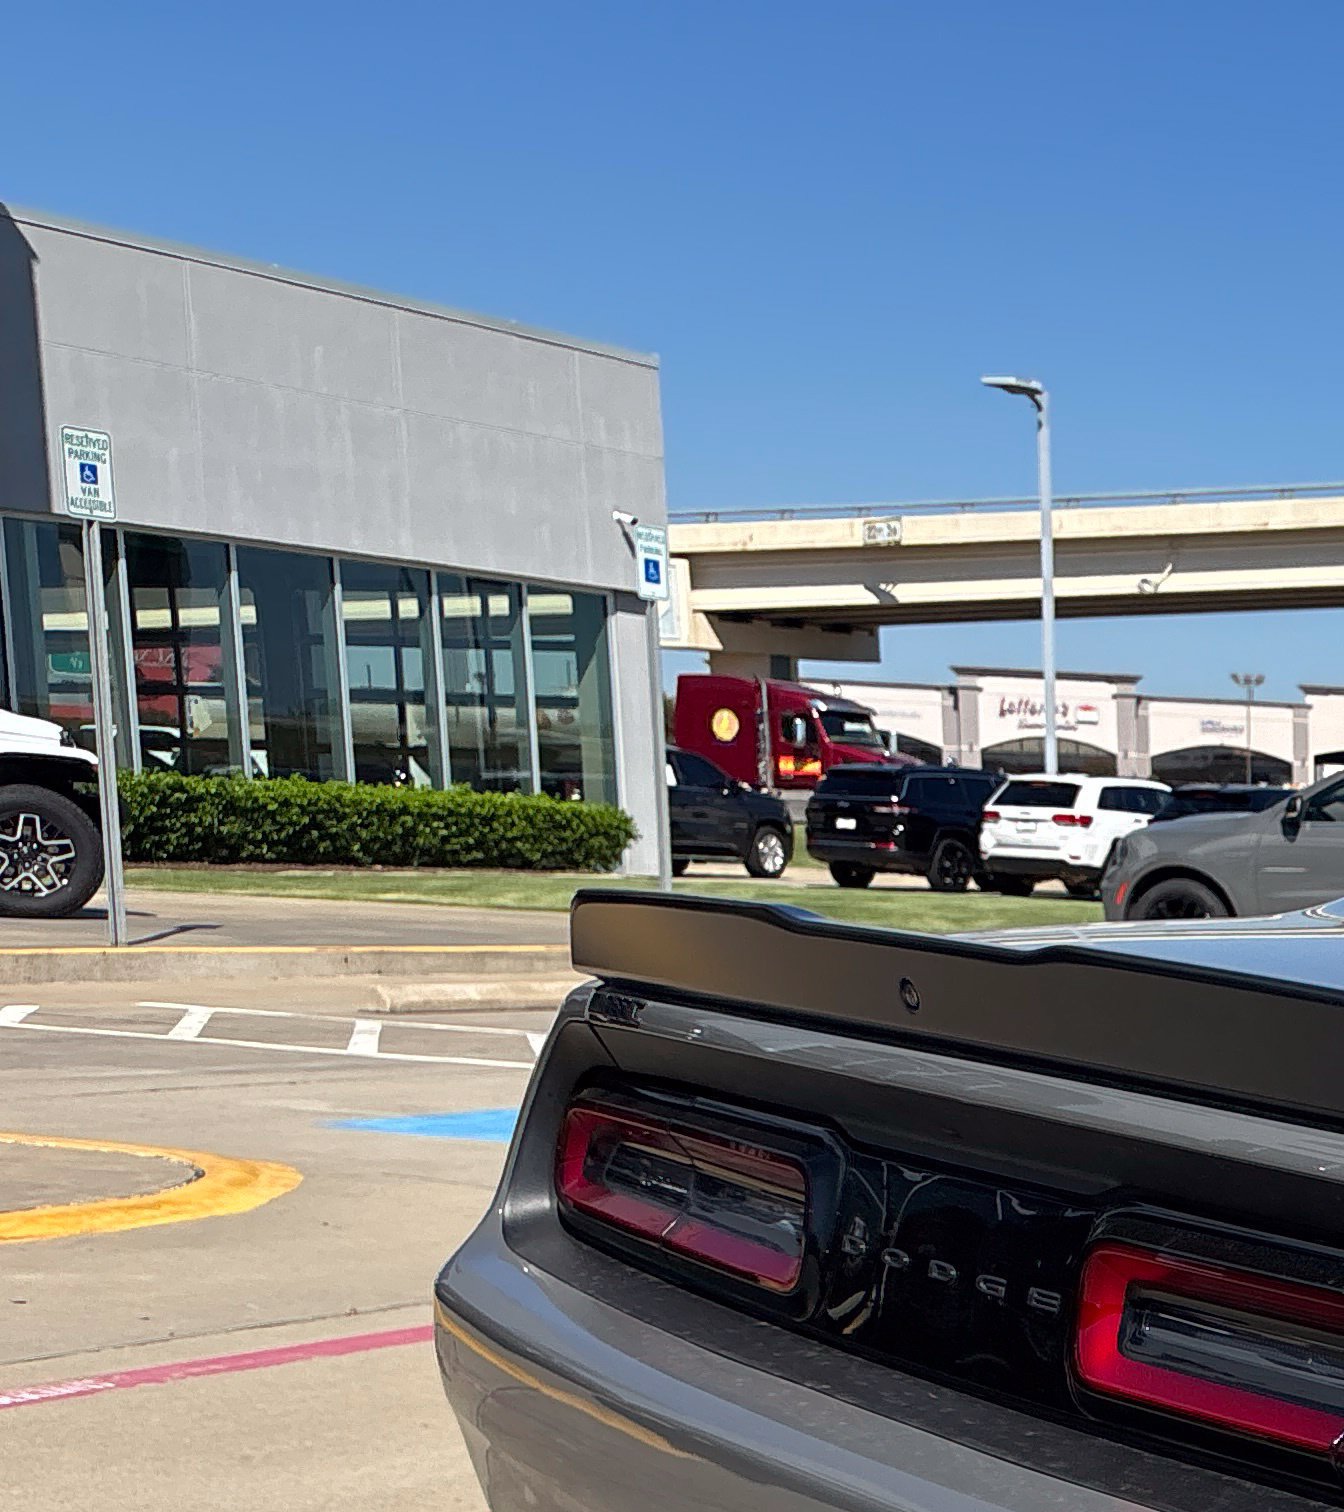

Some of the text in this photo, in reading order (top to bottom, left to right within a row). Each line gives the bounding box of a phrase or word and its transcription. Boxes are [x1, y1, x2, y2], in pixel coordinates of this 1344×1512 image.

[64, 433, 108, 451] RESERVED
[68, 447, 107, 464] PARKING
[80, 486, 100, 498] VAN
[70, 496, 112, 513] ACCESSIBLE
[841, 1234, 1062, 1314] DODGE
